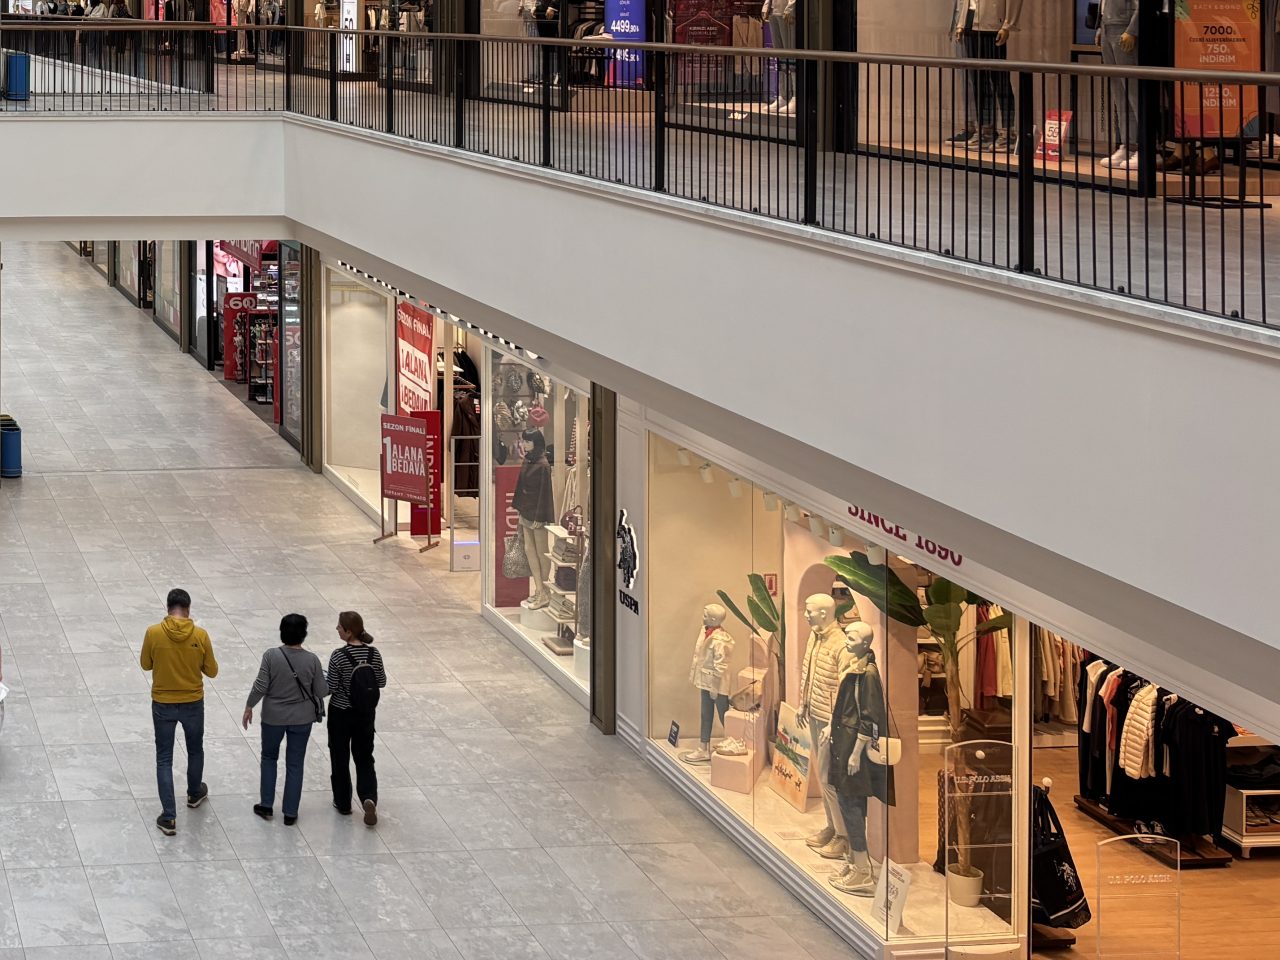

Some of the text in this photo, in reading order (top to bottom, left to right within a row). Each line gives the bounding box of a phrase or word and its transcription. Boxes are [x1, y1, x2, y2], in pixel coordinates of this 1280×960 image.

[1202, 98, 1237, 108] NDİRİM
[405, 351, 429, 385] ALANA
[382, 422, 426, 435] SEZON FİNALİ
[382, 436, 424, 474] 1 ALANA
[391, 458, 426, 477] BEDAVA
[618, 589, 640, 616] USPA
